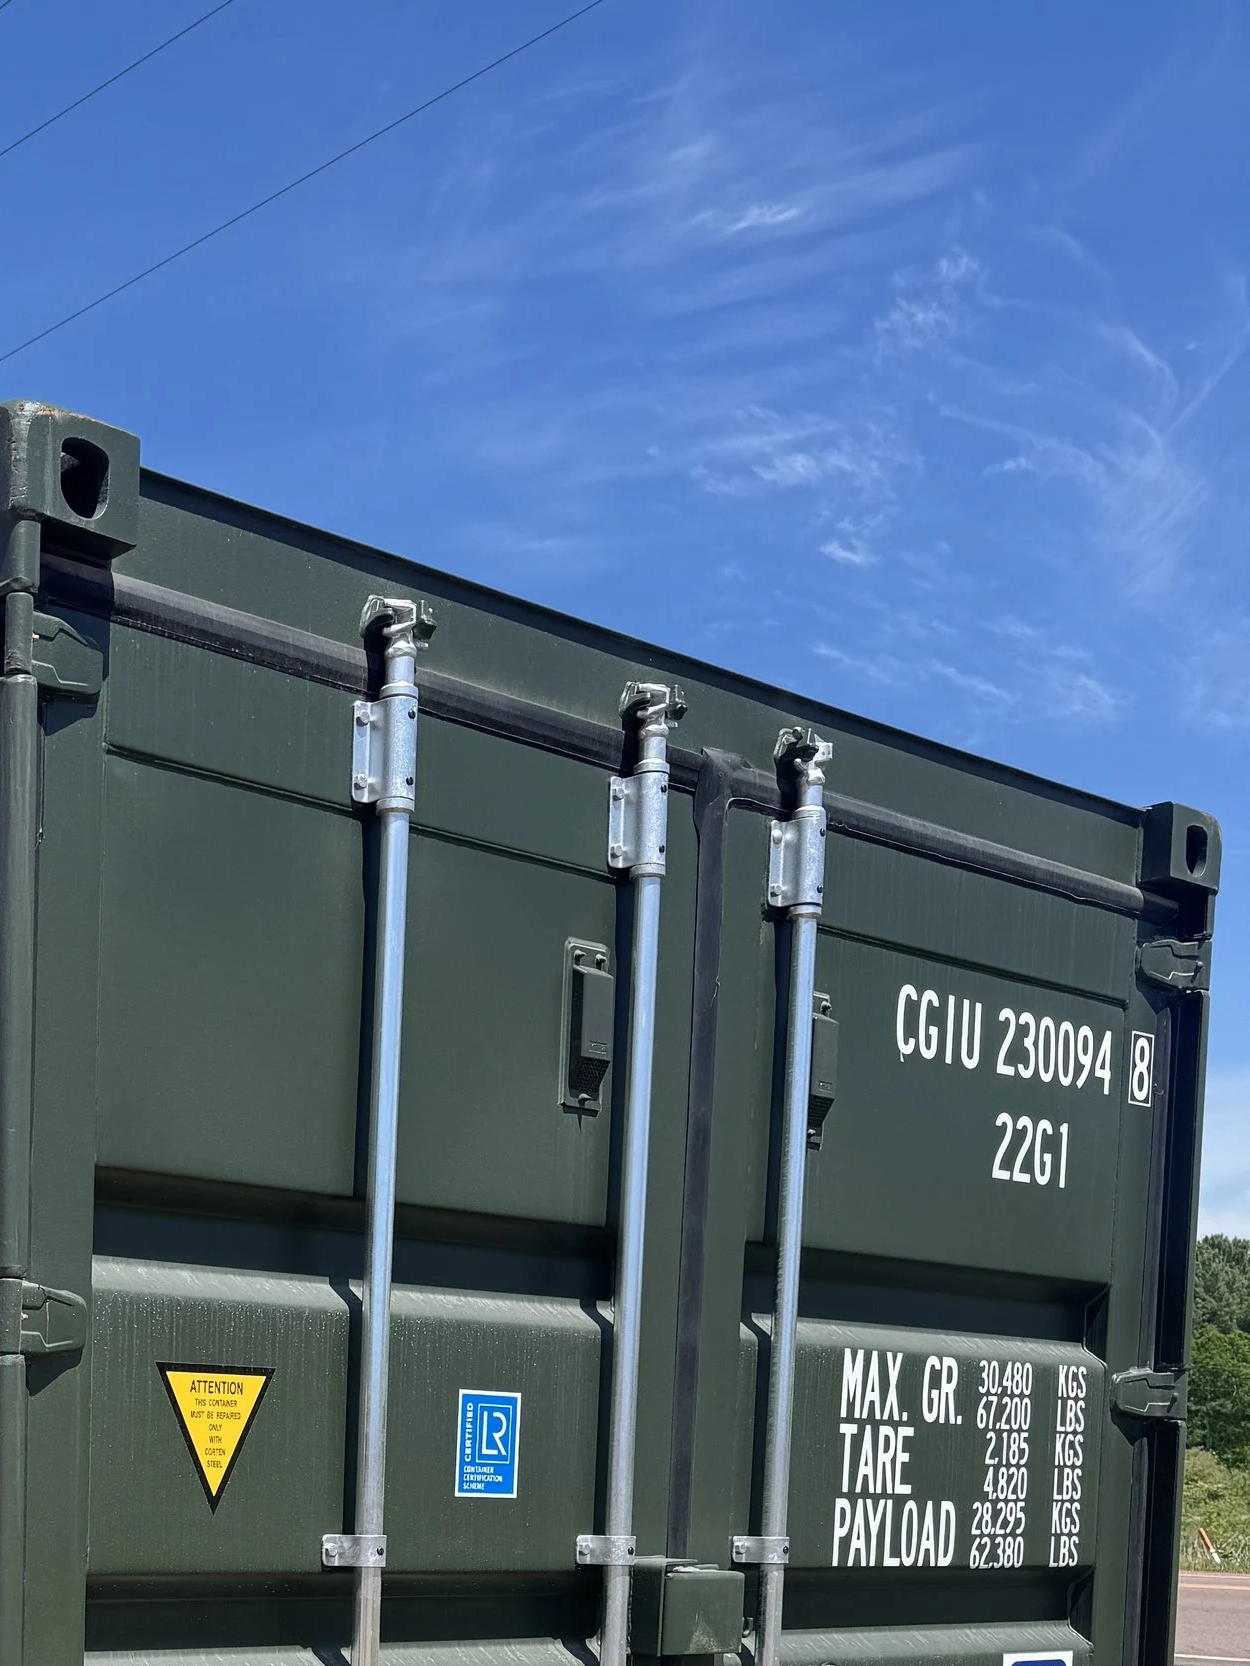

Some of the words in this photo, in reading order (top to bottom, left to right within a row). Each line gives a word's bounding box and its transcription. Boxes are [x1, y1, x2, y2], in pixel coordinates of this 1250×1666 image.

[896, 983, 983, 1070] CGIU
[996, 1007, 1112, 1095] 230094
[1131, 1036, 1151, 1101] 8
[991, 1112, 1069, 1189] 22G1
[190, 1379, 244, 1396] ATTENTION
[839, 1347, 908, 1422] MAX.
[921, 1355, 963, 1425] GR.
[978, 1359, 1033, 1396] 30,480
[1058, 1364, 1087, 1398] KGS
[191, 1410, 205, 1419] MUST
[206, 1411, 214, 1419] BE
[216, 1411, 241, 1420] REPAIRED
[195, 1398, 207, 1407] THIS
[208, 1399, 238, 1408] CONTAINER
[976, 1396, 1031, 1430] 67,200
[1056, 1399, 1086, 1432] LBS
[208, 1423, 222, 1432] ONLY
[208, 1435, 222, 1444] WITH
[464, 1402, 474, 1463] CERTIFIED
[481, 1410, 508, 1456] LR
[204, 1447, 226, 1456] CORTEN
[206, 1459, 223, 1468] STEEL
[839, 1423, 915, 1494] TARE
[984, 1431, 1030, 1466] 2,185
[1054, 1433, 1084, 1467] KGS
[462, 1473, 503, 1482] CERTIFICATION
[463, 1465, 494, 1474] CONTAINER
[462, 1482, 485, 1490] SCHEME
[983, 1466, 1028, 1500] 4,820
[1052, 1467, 1082, 1500] LBS
[831, 1497, 957, 1568] PAYLOAD
[970, 1501, 1026, 1535] 28,295
[1051, 1502, 1081, 1534] KGS
[969, 1536, 1025, 1570] 62,380
[1048, 1536, 1079, 1569] LBS
